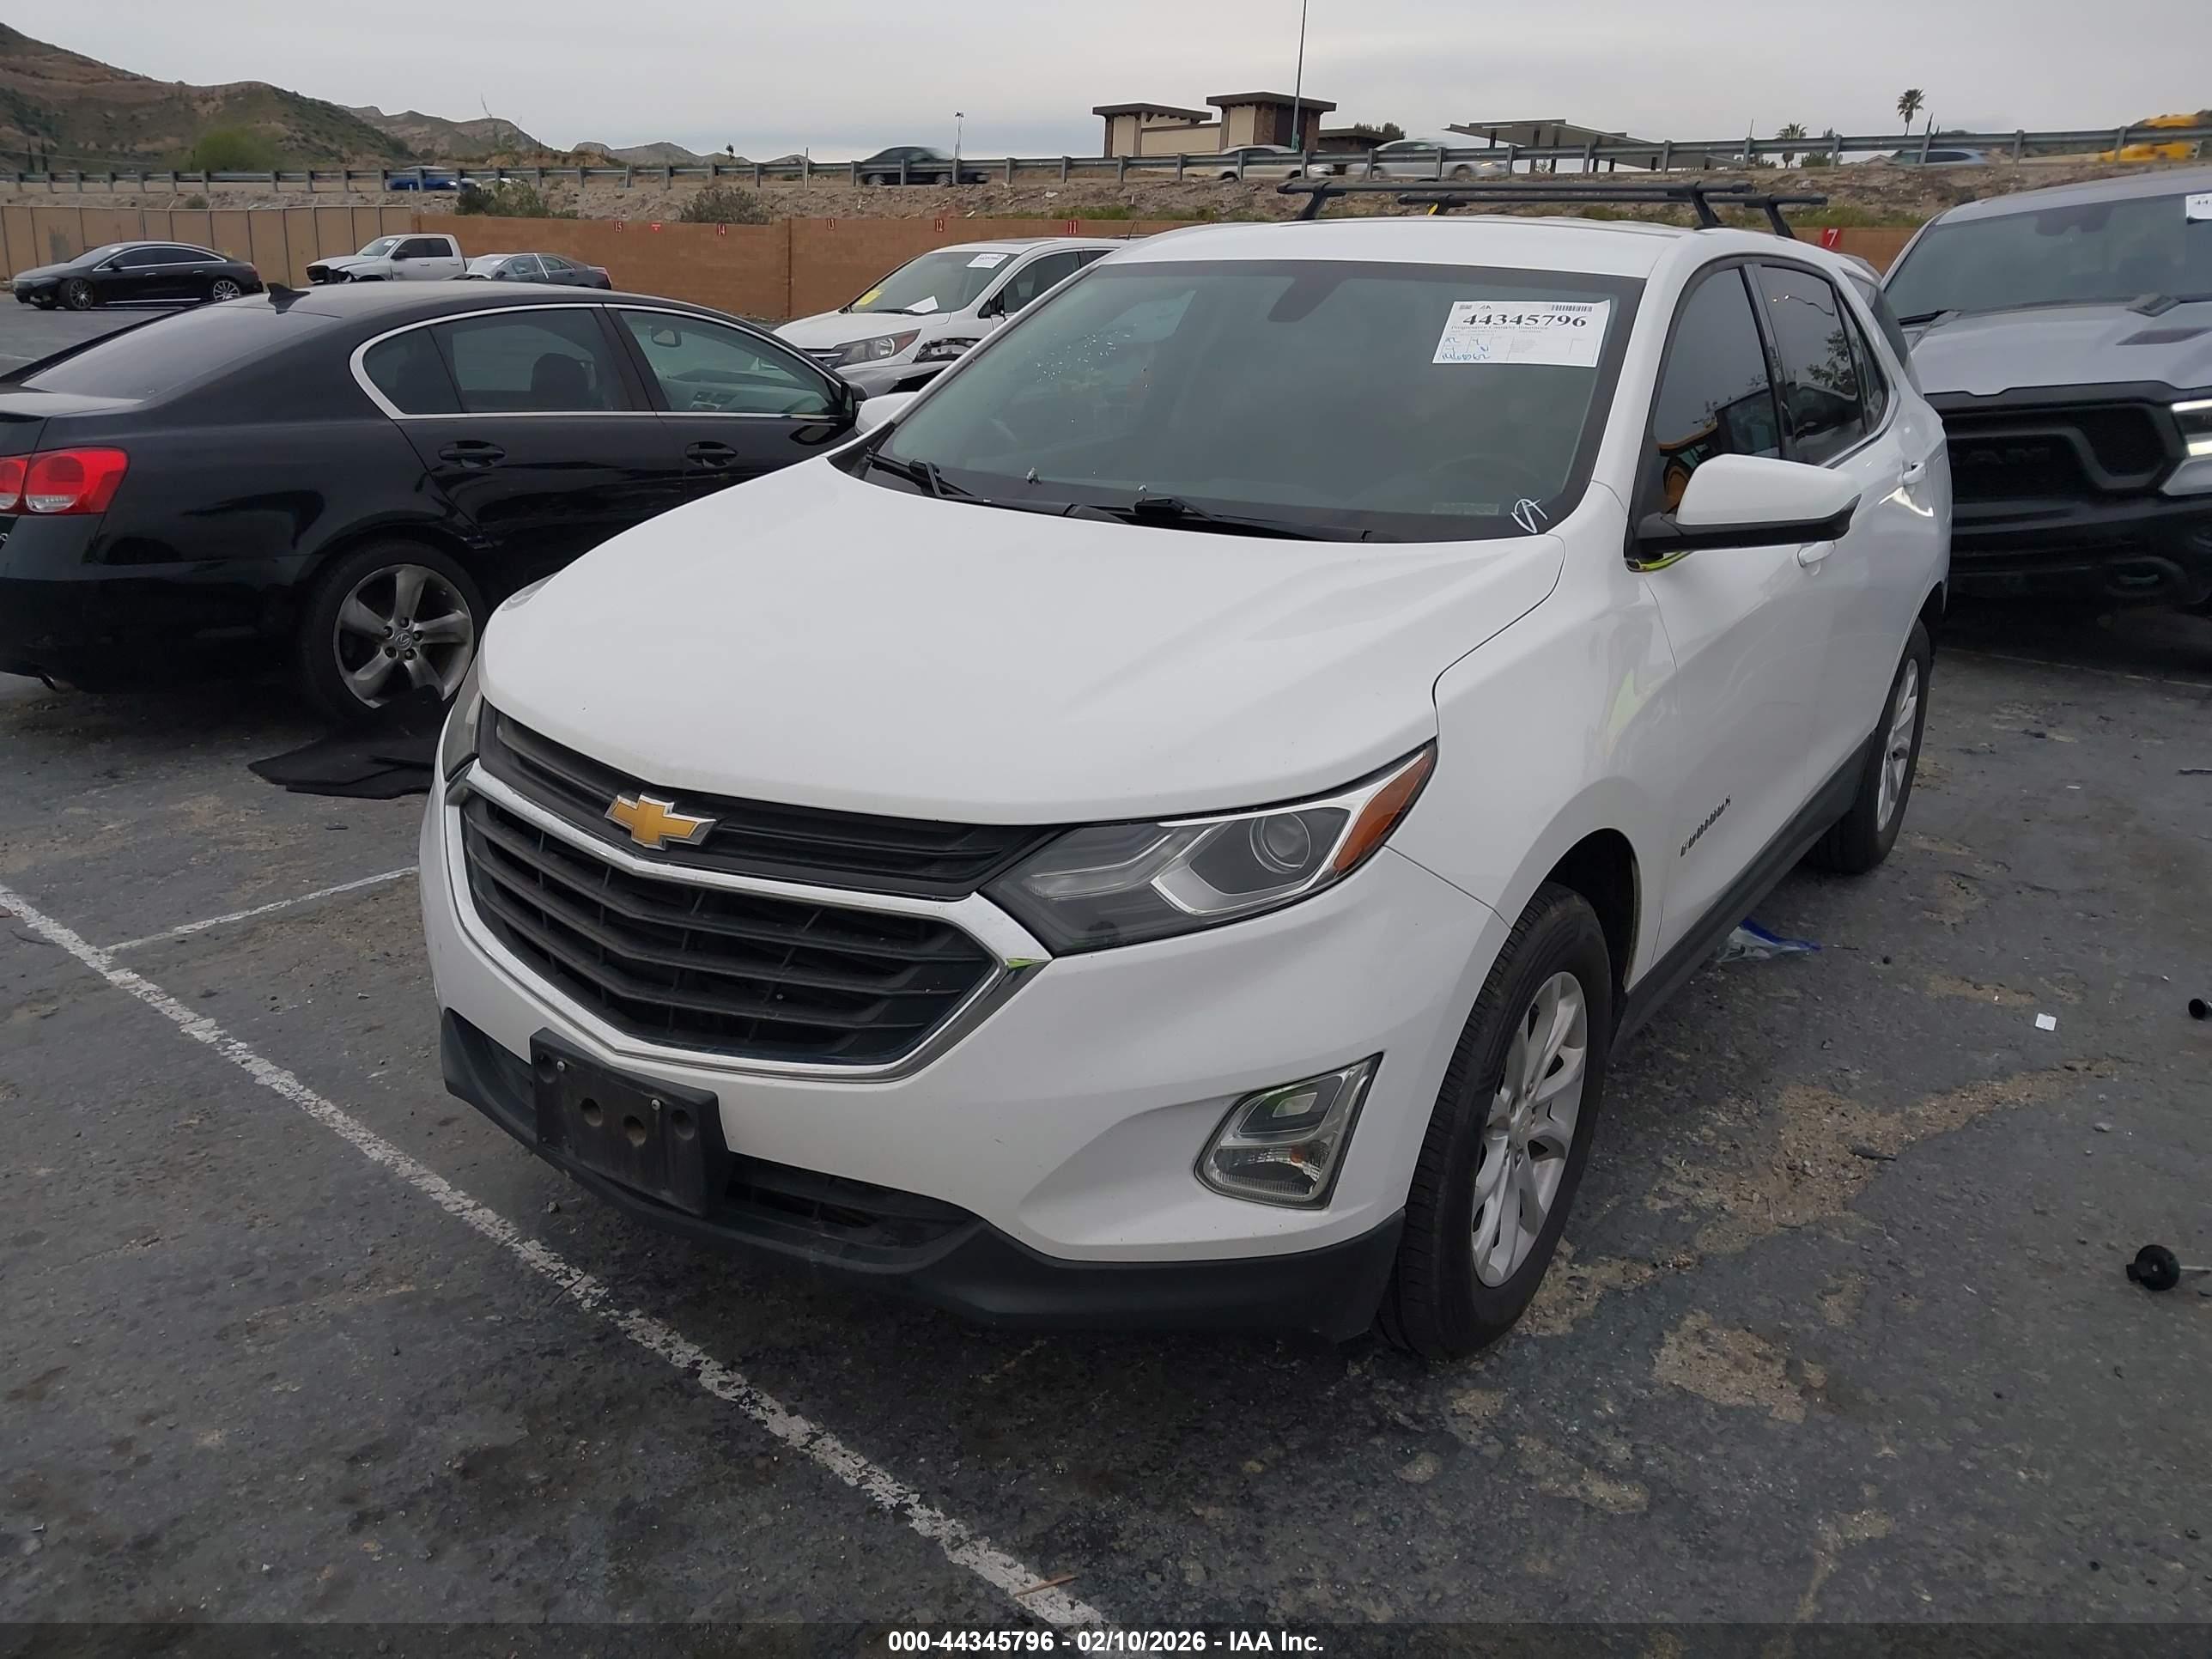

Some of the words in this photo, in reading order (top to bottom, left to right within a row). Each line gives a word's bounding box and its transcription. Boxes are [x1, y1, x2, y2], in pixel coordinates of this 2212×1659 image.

[614, 220, 623, 232] 15
[936, 219, 943, 232] 12
[1069, 221, 1077, 234] 11
[1827, 228, 1838, 246] 7
[1462, 313, 1587, 328] 44345796
